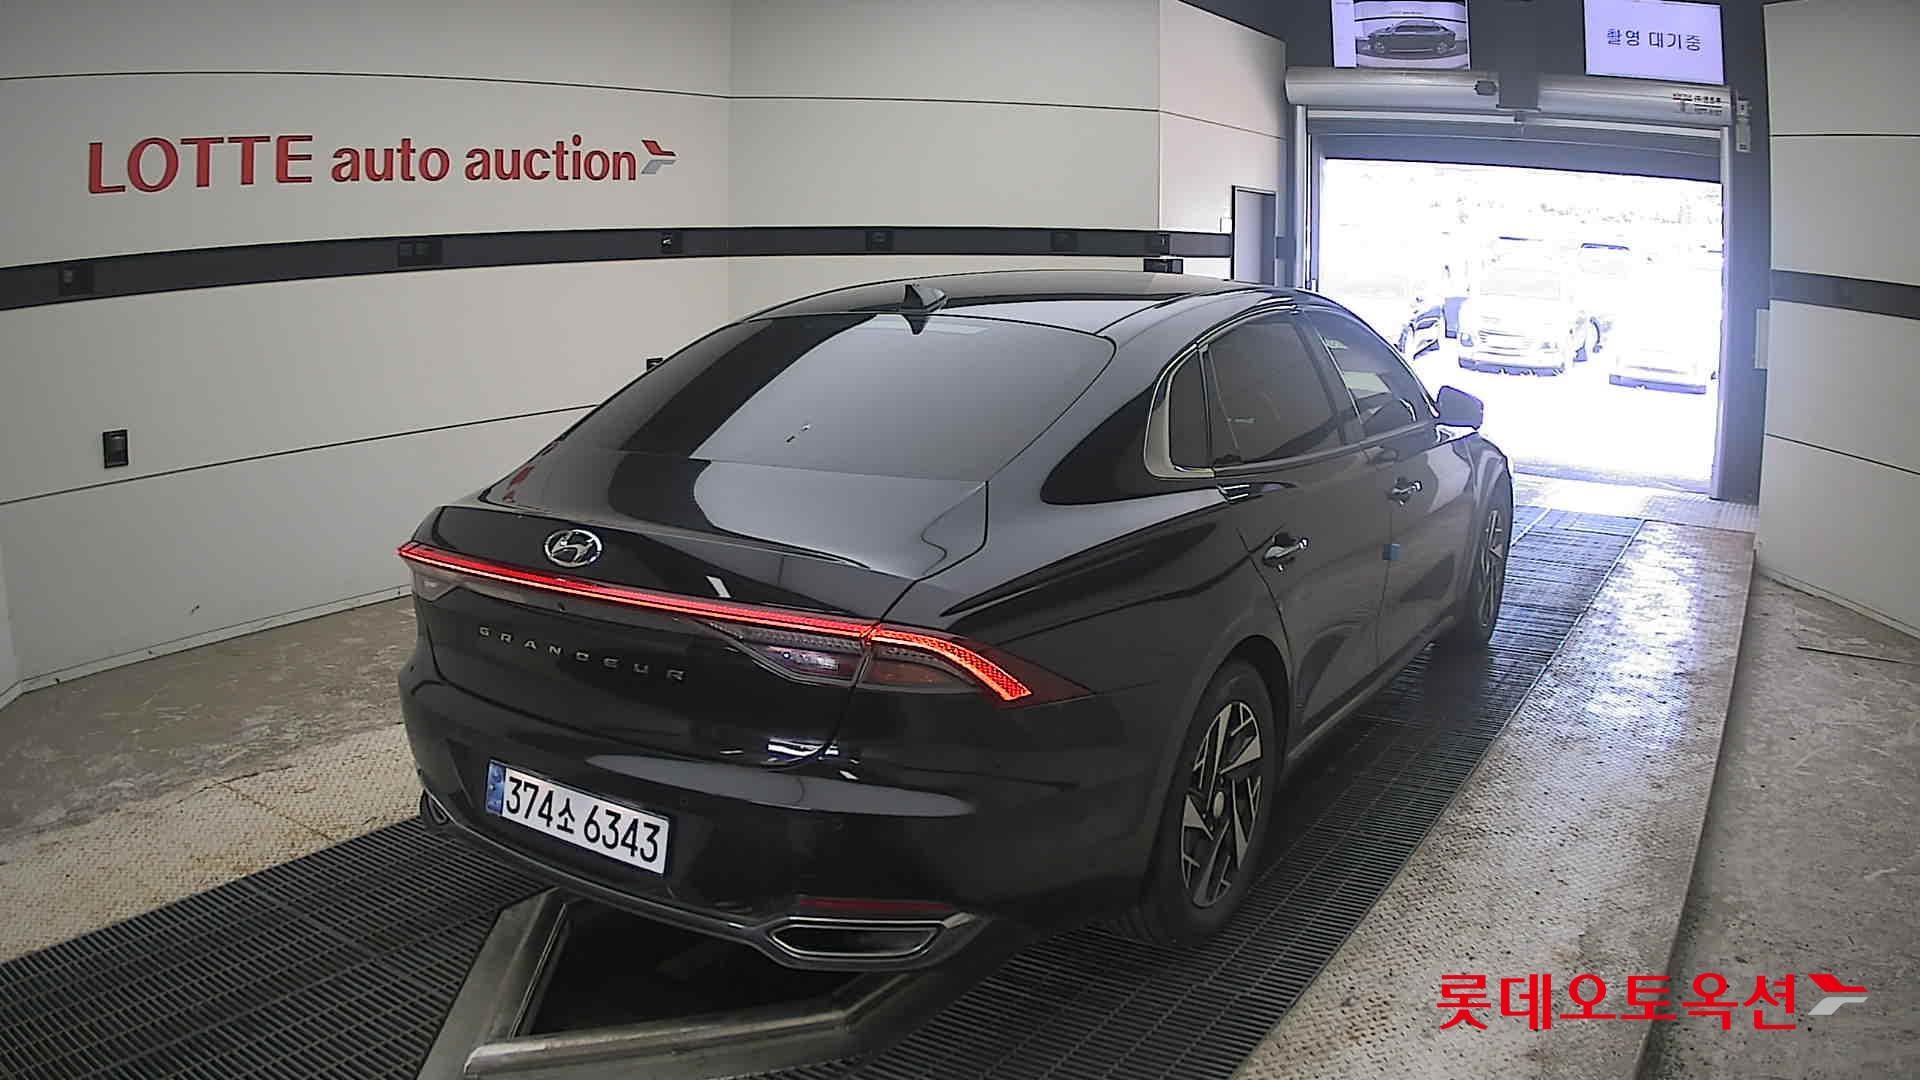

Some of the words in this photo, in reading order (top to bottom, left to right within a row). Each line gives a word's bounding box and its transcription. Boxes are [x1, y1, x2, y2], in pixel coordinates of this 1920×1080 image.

[88, 135, 313, 194] LOTTE
[331, 138, 450, 182] auto
[464, 134, 637, 182] auction
[478, 625, 686, 682] GRANDEUR
[505, 776, 575, 835] 374소
[583, 804, 661, 864] 6343
